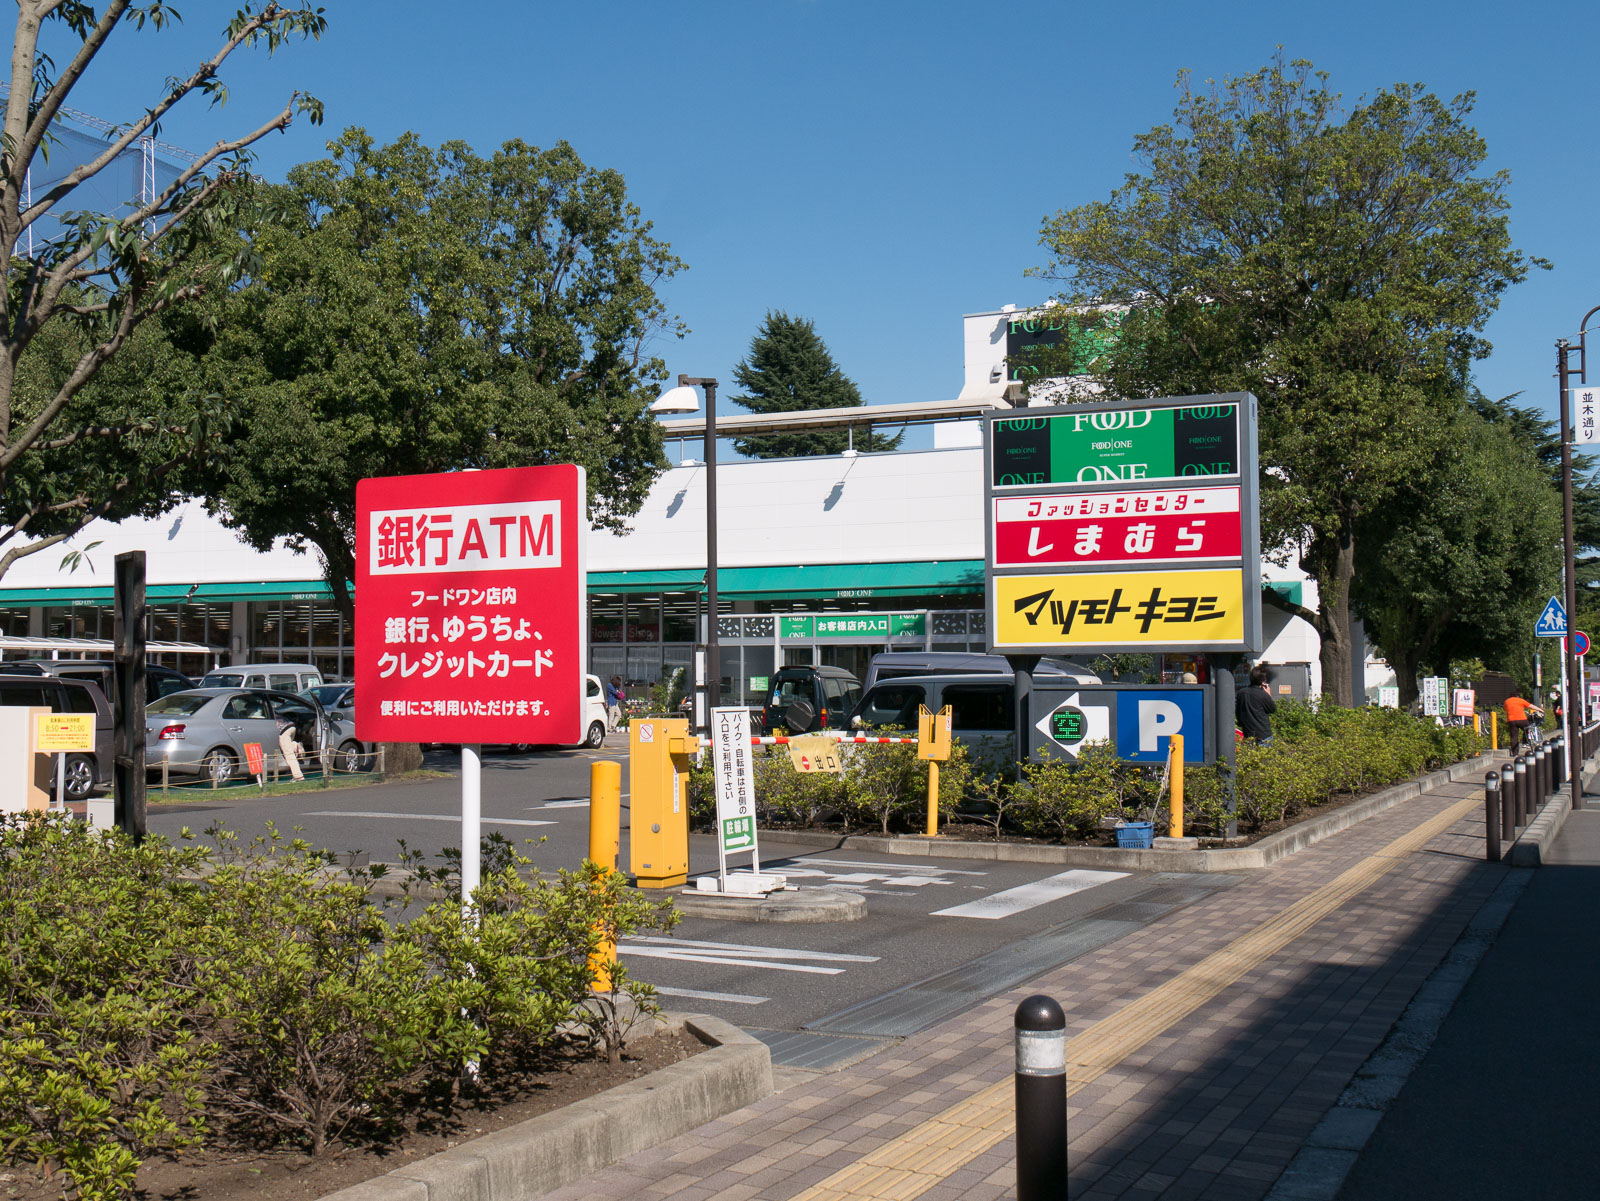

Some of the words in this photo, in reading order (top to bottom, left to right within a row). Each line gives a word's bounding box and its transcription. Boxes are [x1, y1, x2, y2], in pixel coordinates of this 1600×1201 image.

[1072, 410, 1152, 432] FOOD
[1179, 405, 1233, 420] FOOD
[1582, 392, 1595, 440] 並木通り
[996, 417, 1047, 432] FOOD
[1091, 441, 1112, 450] FOOD
[1113, 440, 1133, 448] ONE
[1000, 472, 1045, 486] ONE
[1077, 463, 1148, 482] ONE
[1181, 462, 1231, 477] ONE
[1028, 495, 1205, 517] ファッションセンター
[378, 513, 554, 568] 銀行ATM
[1027, 520, 1206, 557] しまむら
[411, 587, 516, 607] フードワン店内
[1014, 587, 1226, 634] マツモトキヨシ
[385, 615, 543, 644] 銀行、ゆうちょ、
[818, 619, 888, 632] お客様店内入口
[378, 649, 554, 678] クレジットカード
[380, 700, 550, 716] 便利にご利用いただけます。
[1053, 711, 1081, 739] 空
[1138, 700, 1184, 752] P
[720, 713, 734, 800] 入口をご利用下さい
[732, 713, 748, 815] バイク・自転車は右側の
[814, 755, 836, 770] 出口
[726, 818, 750, 835] 駐輪場
